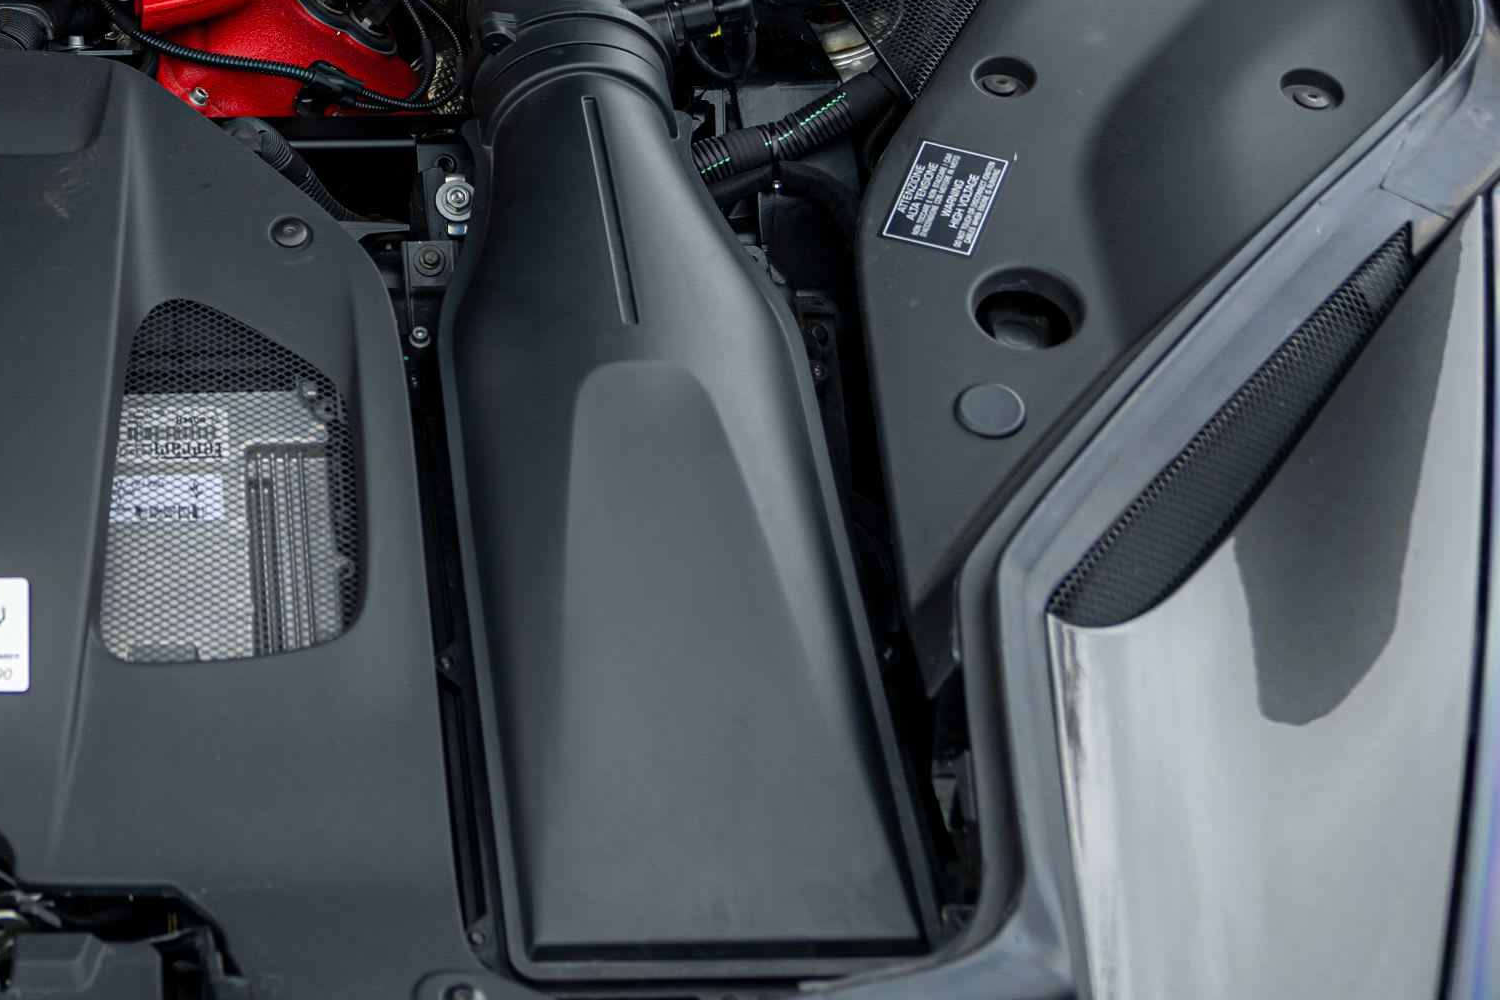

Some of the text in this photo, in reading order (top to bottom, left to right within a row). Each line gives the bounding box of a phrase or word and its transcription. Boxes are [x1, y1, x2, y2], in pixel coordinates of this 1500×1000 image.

[897, 163, 925, 213] ATTENZIONE
[905, 161, 938, 220] ALTA TENSIONE
[940, 178, 964, 217] WARNING
[948, 173, 979, 229] HIGH VOLTAGE
